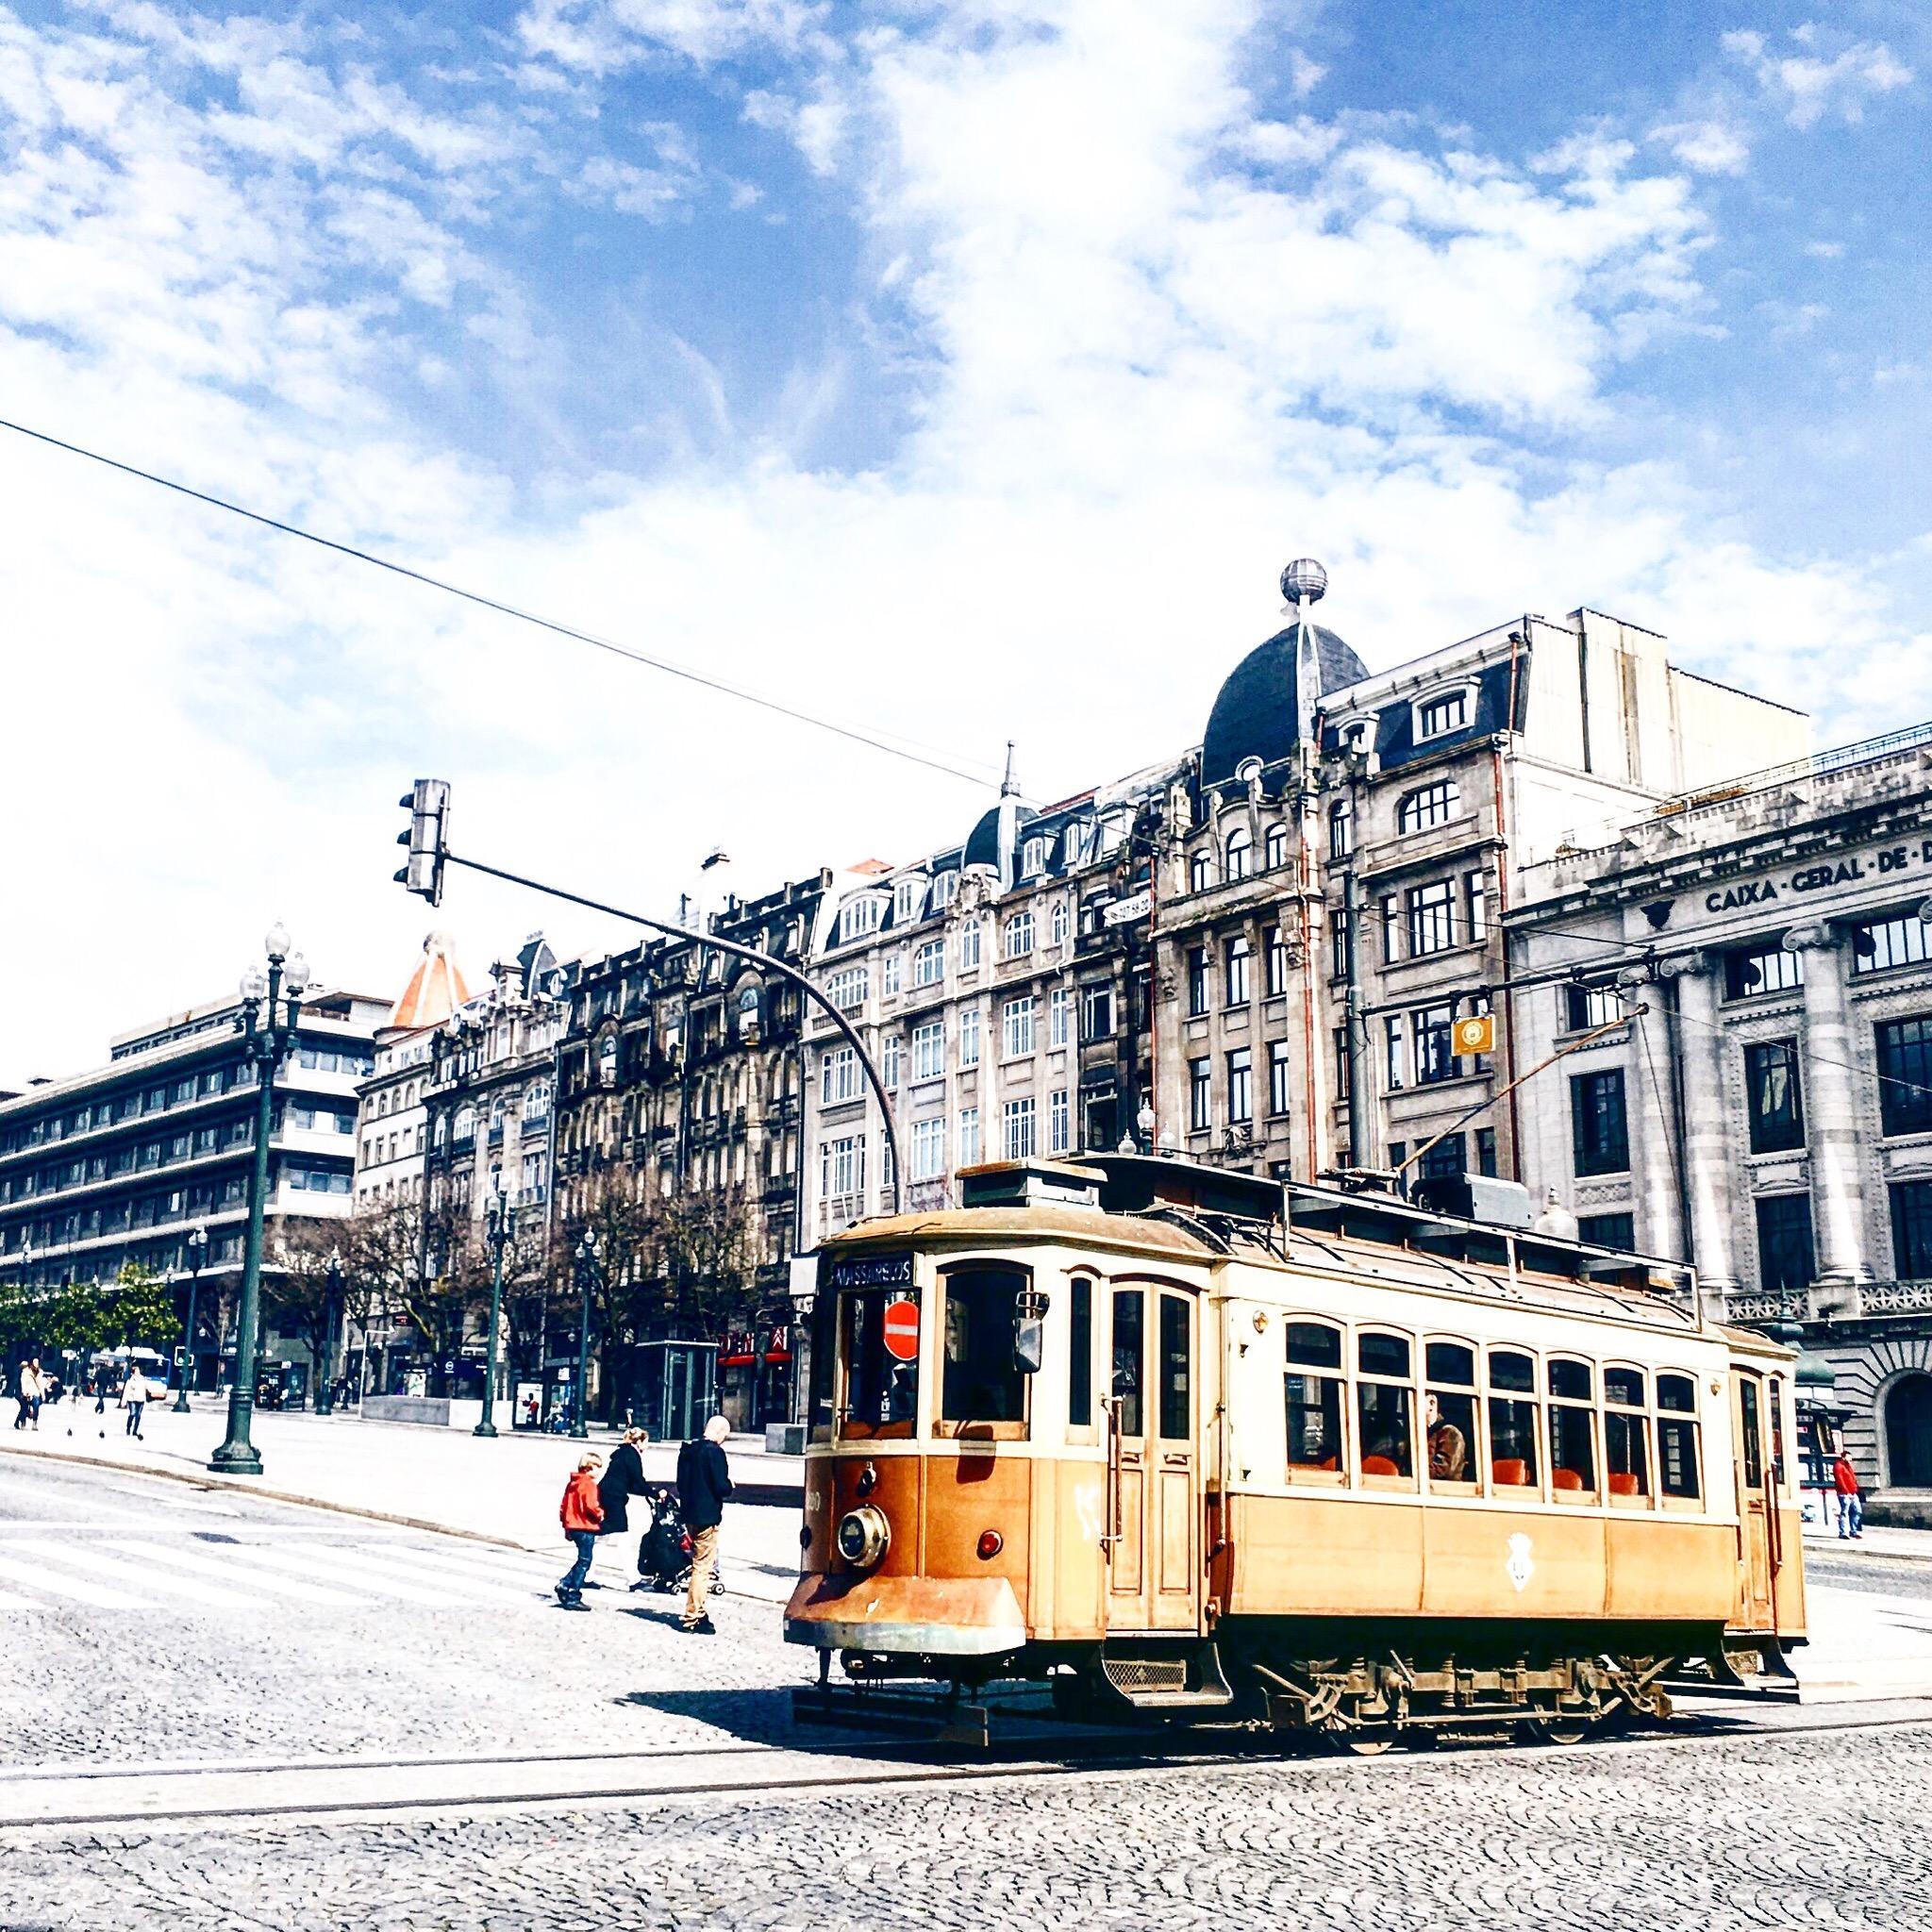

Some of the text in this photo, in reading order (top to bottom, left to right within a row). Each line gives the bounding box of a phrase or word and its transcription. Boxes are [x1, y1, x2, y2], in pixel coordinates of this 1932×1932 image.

[1706, 880, 1777, 912] CAIXA
[1791, 858, 1866, 892] GERAL
[1878, 846, 1908, 874] DE
